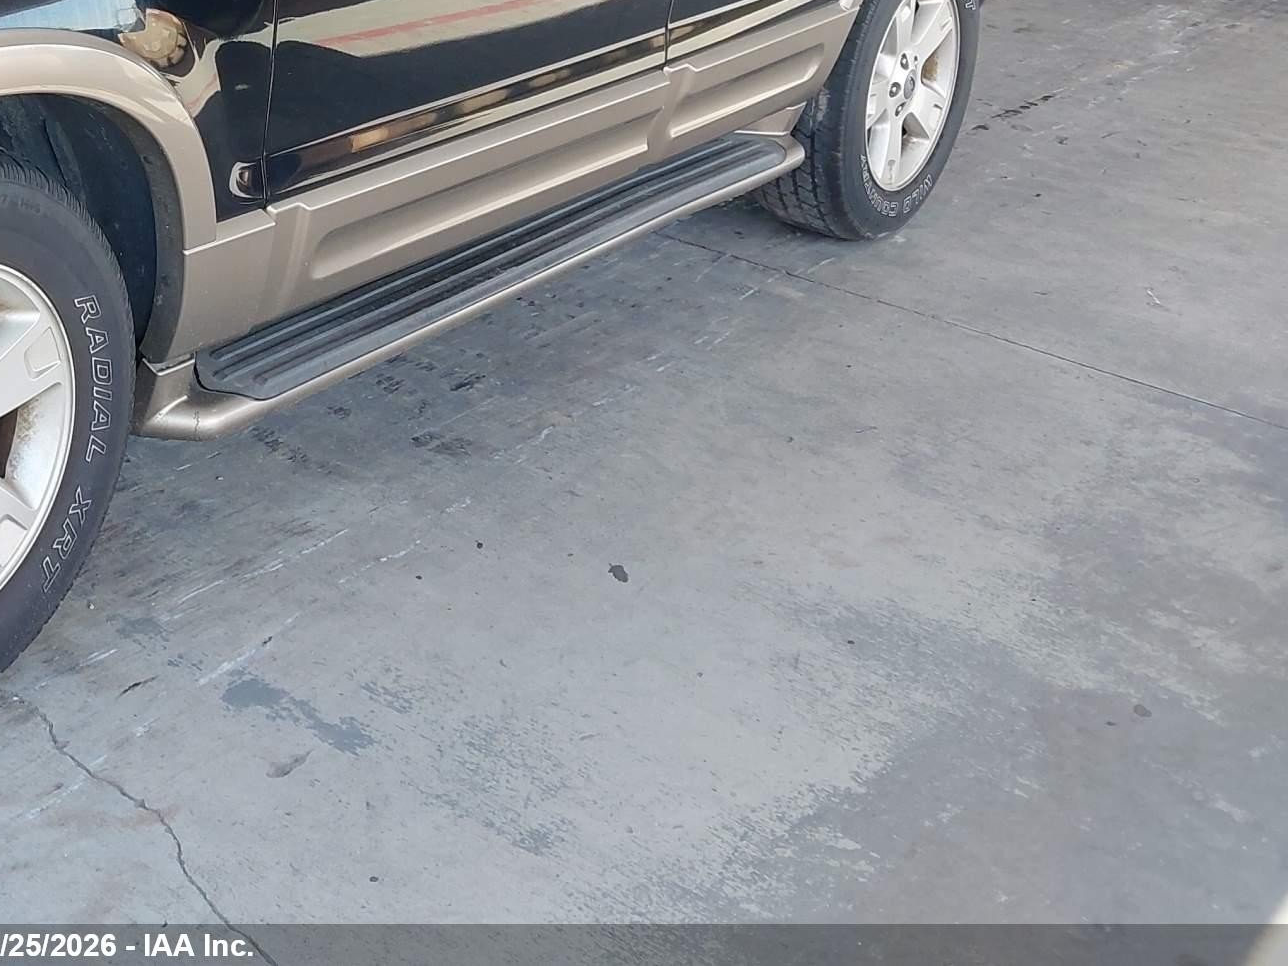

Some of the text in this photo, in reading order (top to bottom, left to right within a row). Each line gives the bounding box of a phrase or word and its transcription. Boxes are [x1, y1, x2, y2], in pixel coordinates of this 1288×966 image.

[903, 174, 933, 214] WILD
[41, 294, 114, 594] RADIAL XRT
